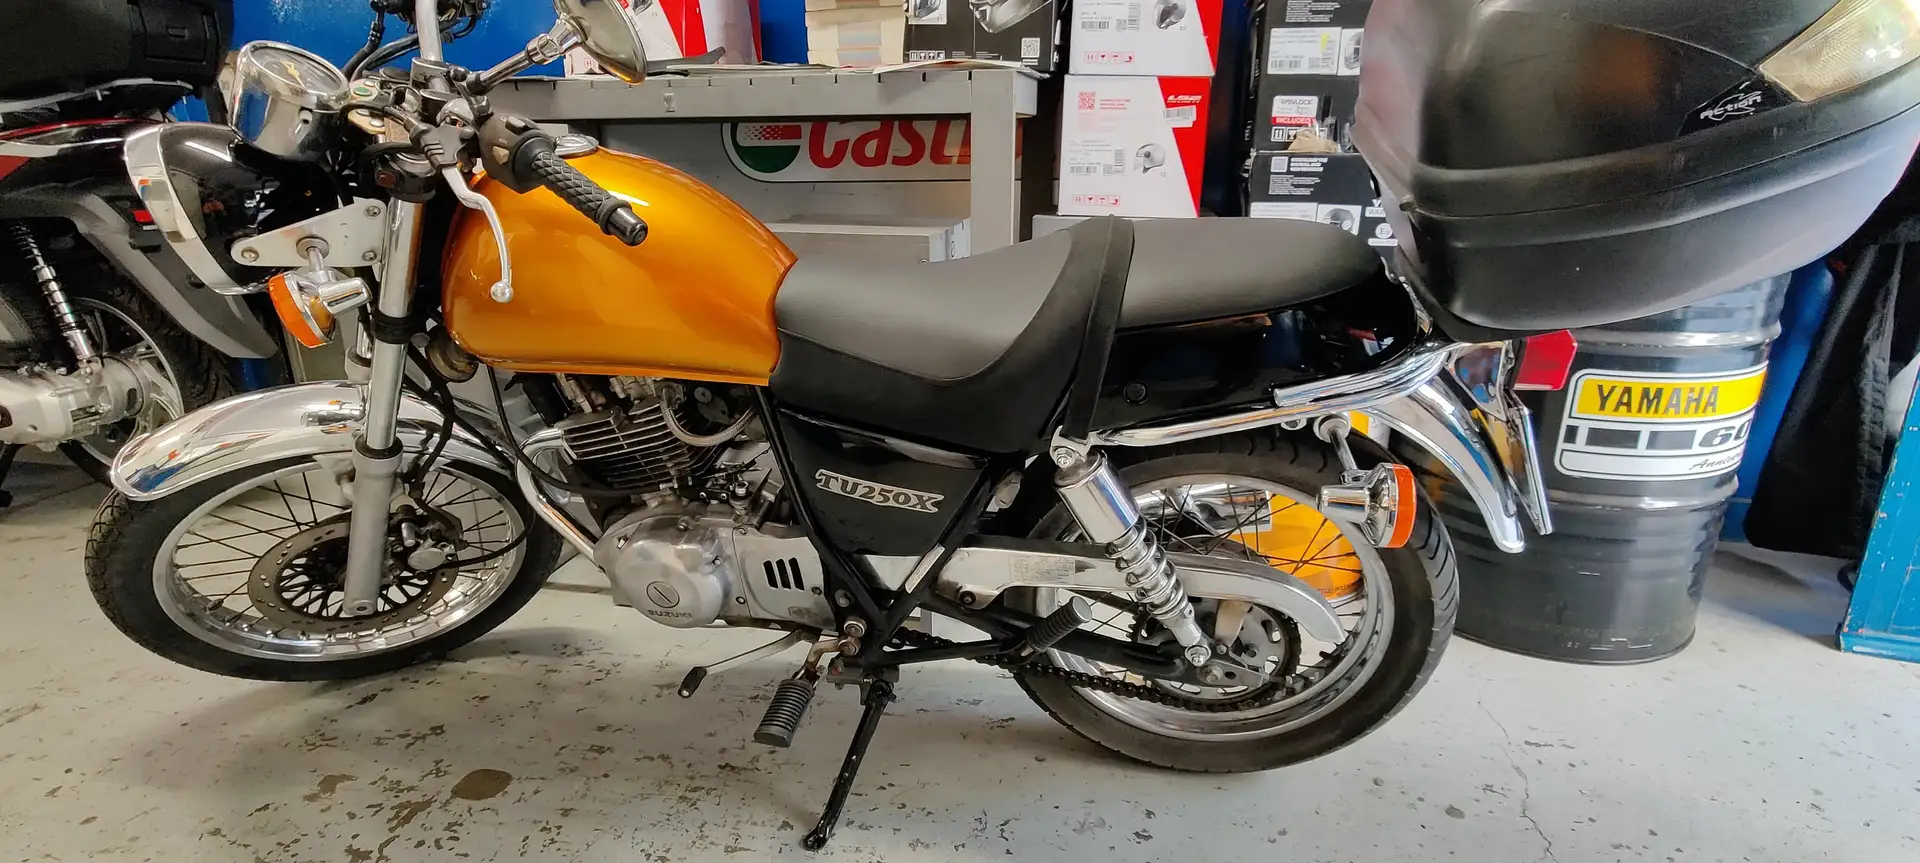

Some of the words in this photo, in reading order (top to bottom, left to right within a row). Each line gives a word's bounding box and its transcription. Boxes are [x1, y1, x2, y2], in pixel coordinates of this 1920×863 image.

[1597, 384, 1719, 415] YAMAHA
[819, 471, 941, 512] TU250X
[646, 608, 693, 619] SUZUKI
